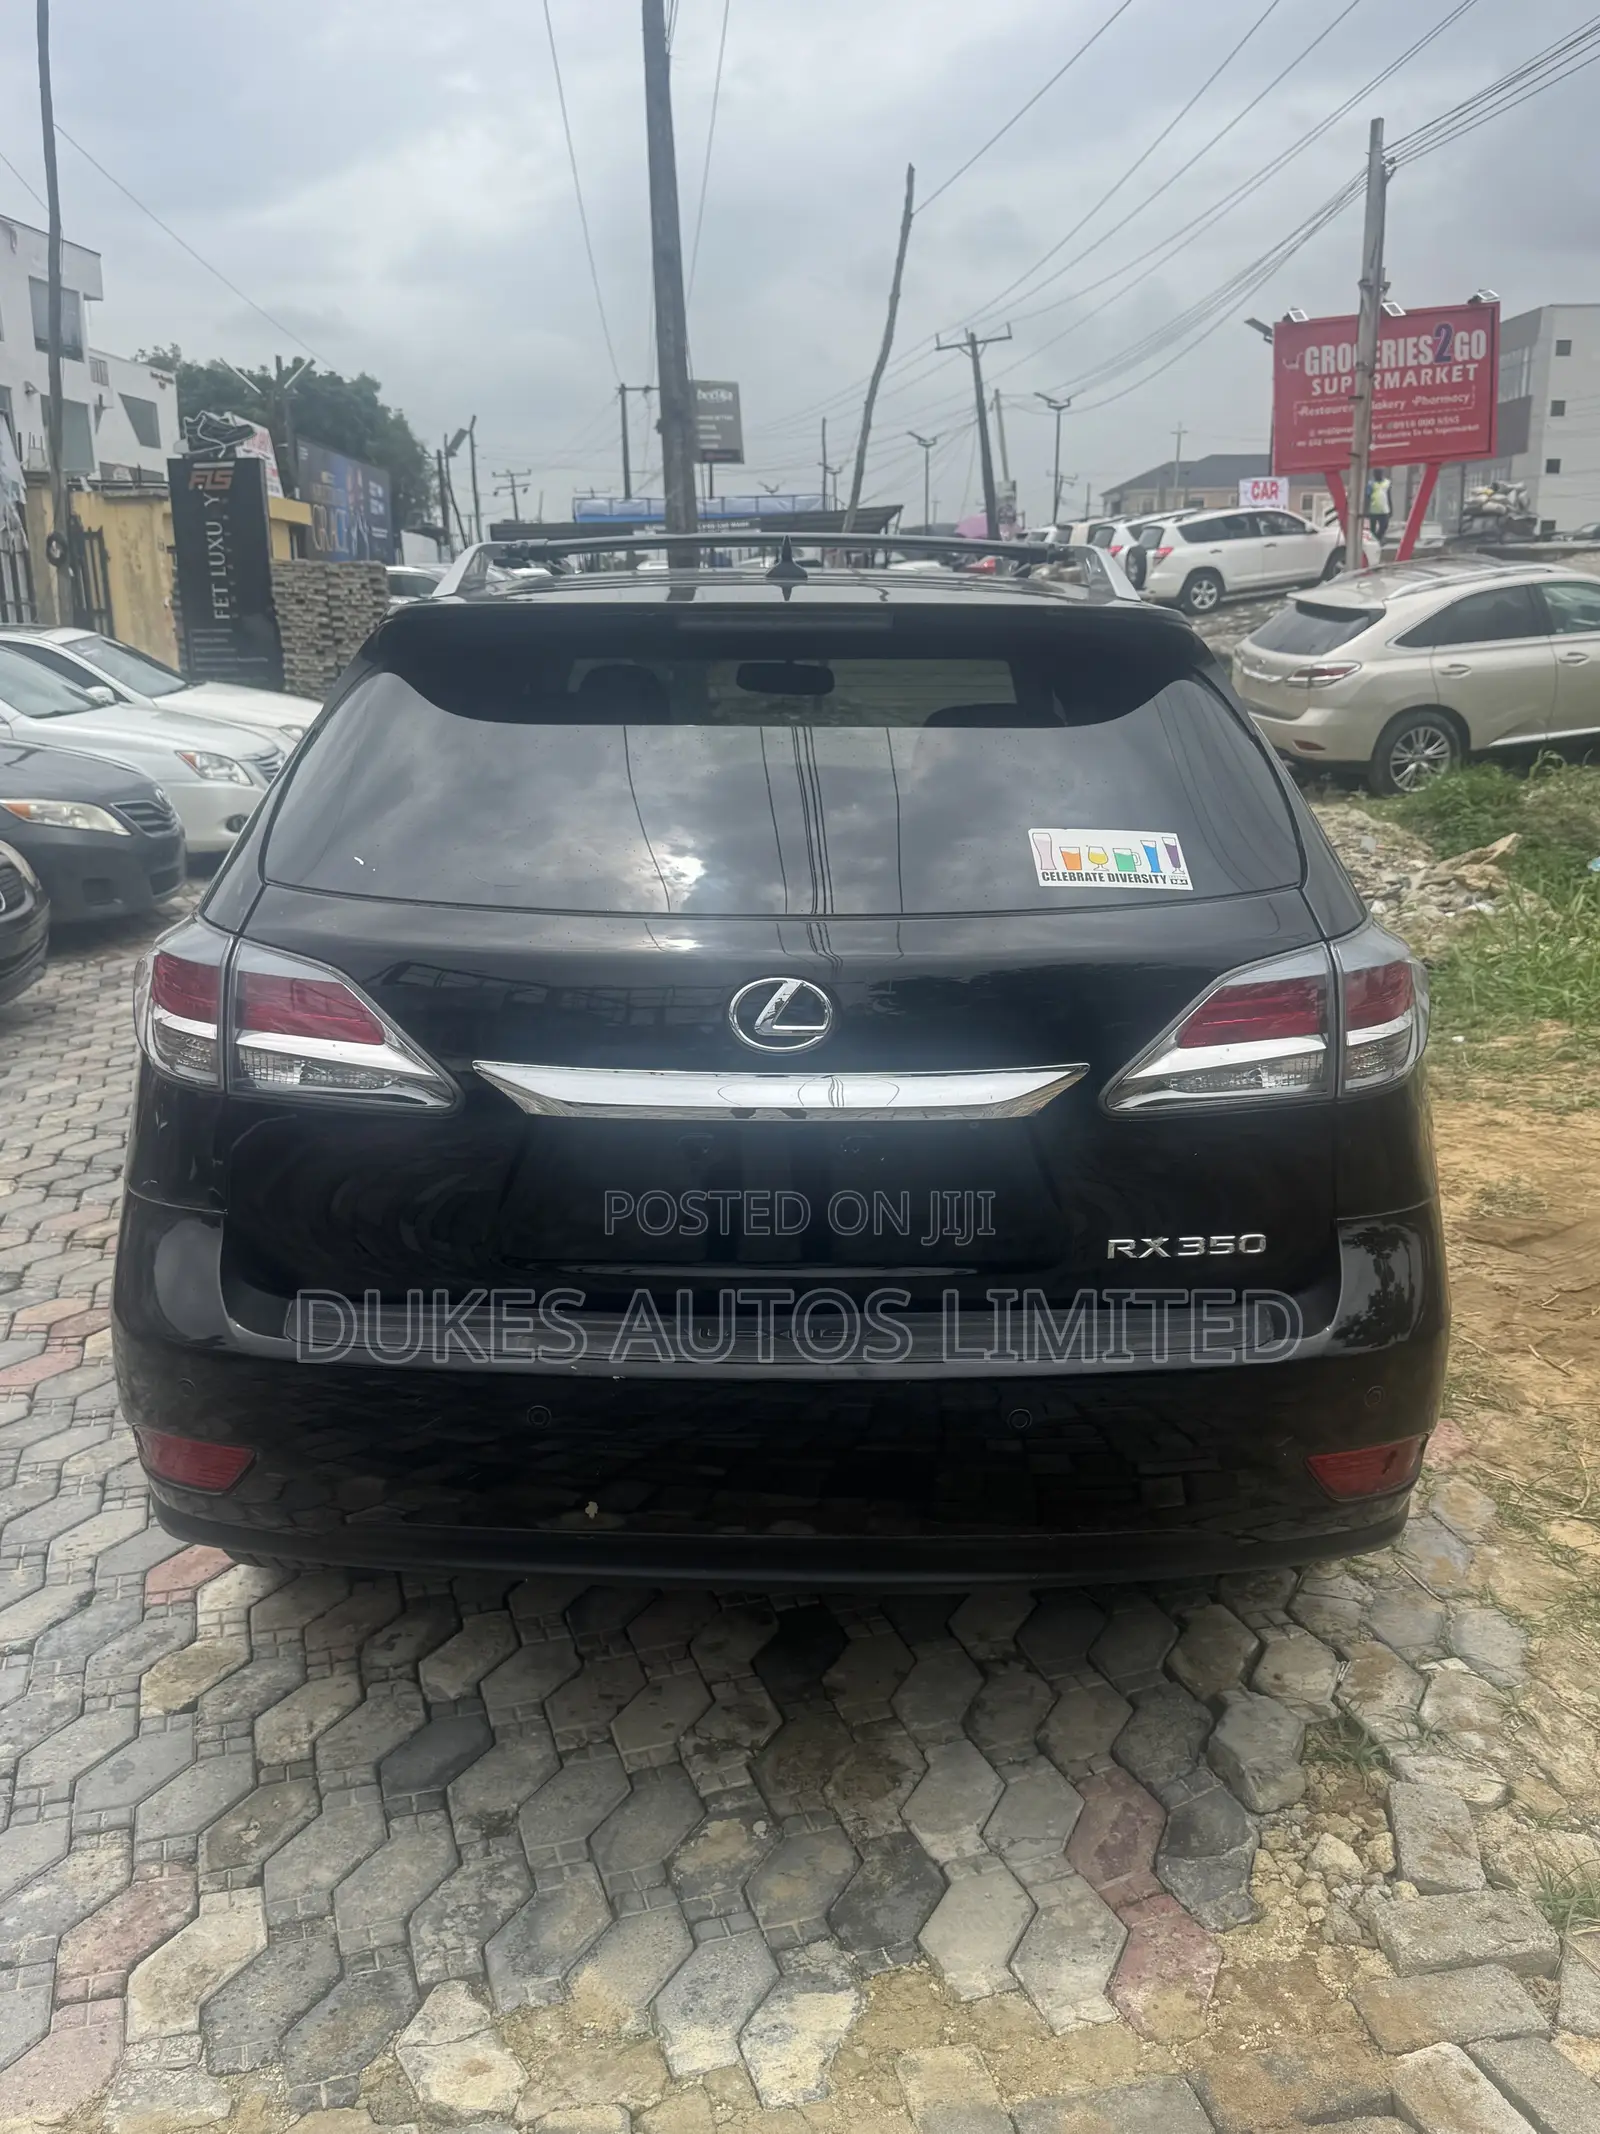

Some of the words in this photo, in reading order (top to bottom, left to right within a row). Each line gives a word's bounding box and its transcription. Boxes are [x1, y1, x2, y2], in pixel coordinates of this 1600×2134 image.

[1304, 321, 1488, 377] GRORIES2GO
[1311, 363, 1479, 397] SUPRMARKET
[1371, 399, 1406, 412] akery
[1250, 480, 1280, 501] CAR
[1041, 871, 1106, 883] CELEBRATE
[1107, 873, 1168, 885] DIVERSITY
